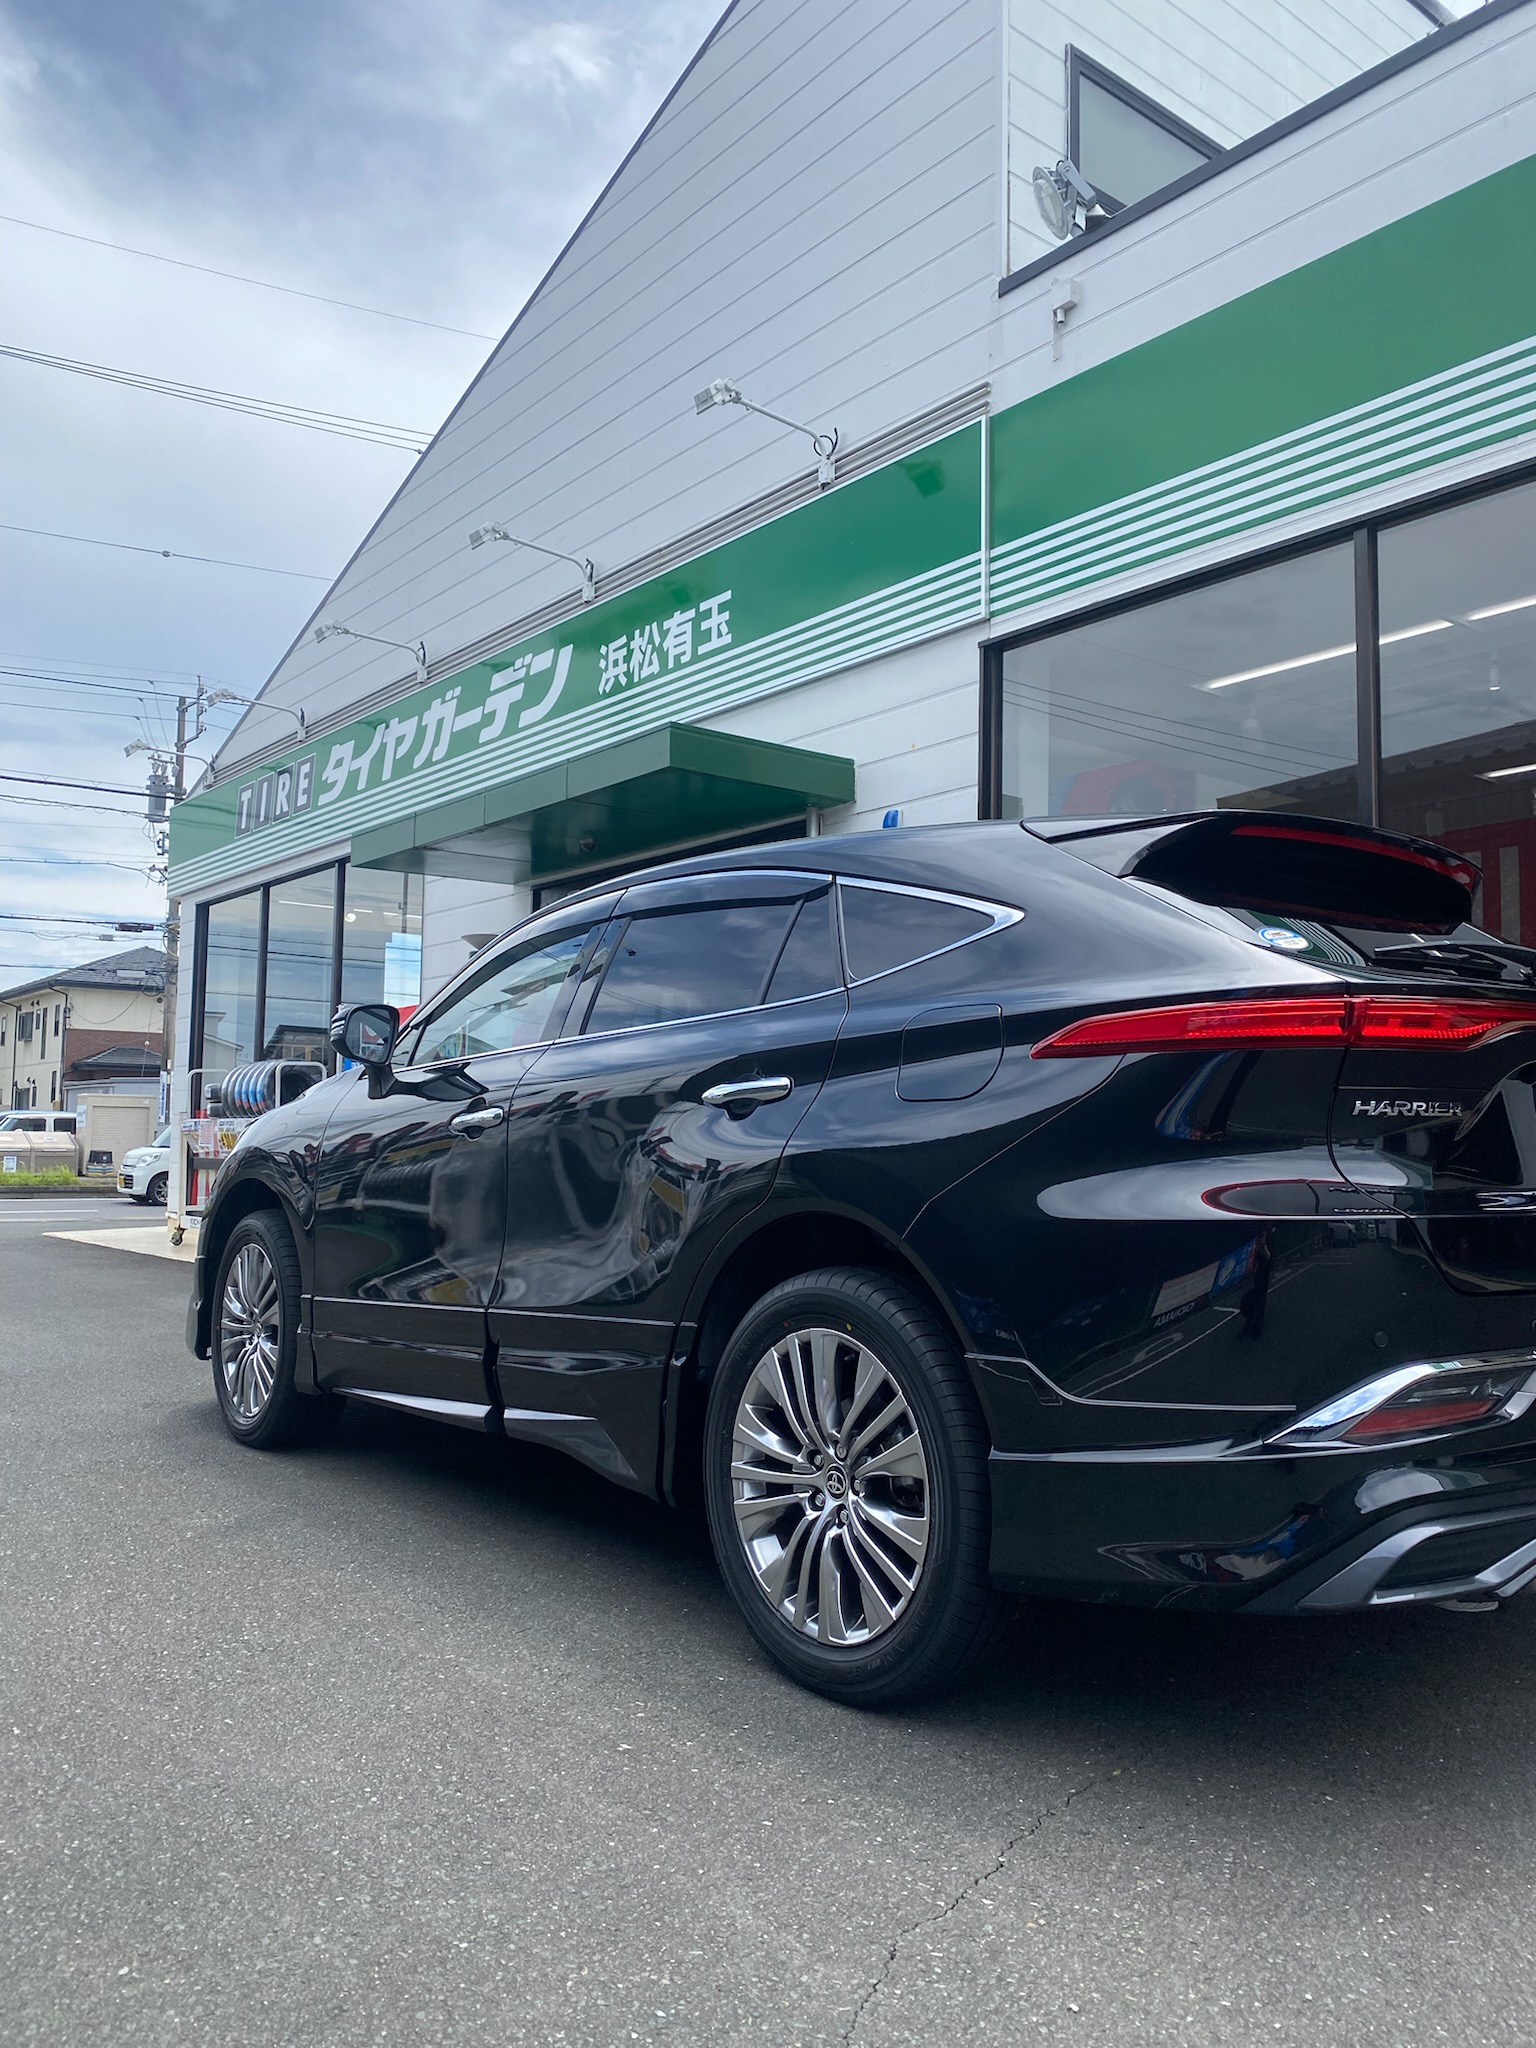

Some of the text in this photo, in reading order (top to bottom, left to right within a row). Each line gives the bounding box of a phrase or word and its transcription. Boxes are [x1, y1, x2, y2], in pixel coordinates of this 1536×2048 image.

[241, 590, 733, 829] TIRE タイヤガーデン 浜松有玉
[1352, 1100, 1463, 1117] HARRIER
